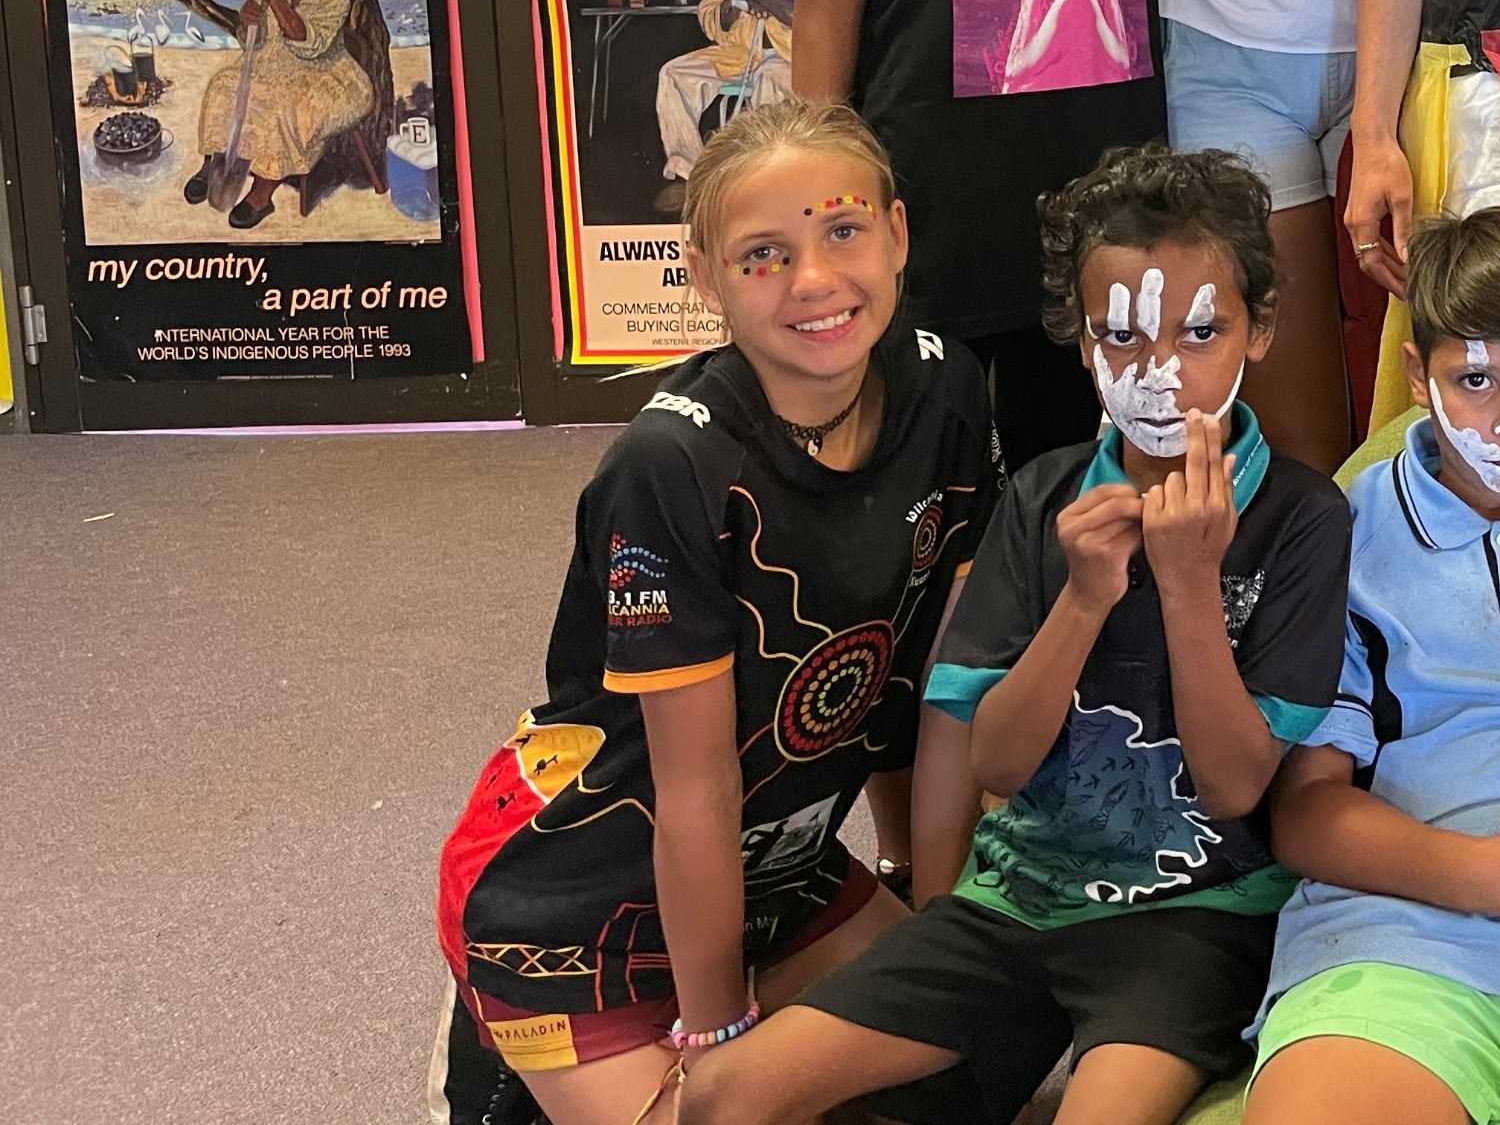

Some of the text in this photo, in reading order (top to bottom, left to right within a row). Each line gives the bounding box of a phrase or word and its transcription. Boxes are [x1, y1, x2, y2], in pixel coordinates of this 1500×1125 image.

[599, 241, 680, 261] ALWAYS
[88, 254, 269, 288] my country,
[262, 282, 448, 317] a part of me
[602, 303, 711, 315] COMMEMORAT
[154, 325, 389, 343] INTERNATIONAL YEAR FOR THE
[627, 320, 726, 332] BUYING BACK
[137, 343, 411, 361] WORLD'S INDIGENOUS PEOPLE 1993
[640, 590, 667, 604] FM
[626, 615, 672, 627] RADIO
[505, 1020, 567, 1040] PALADIN
